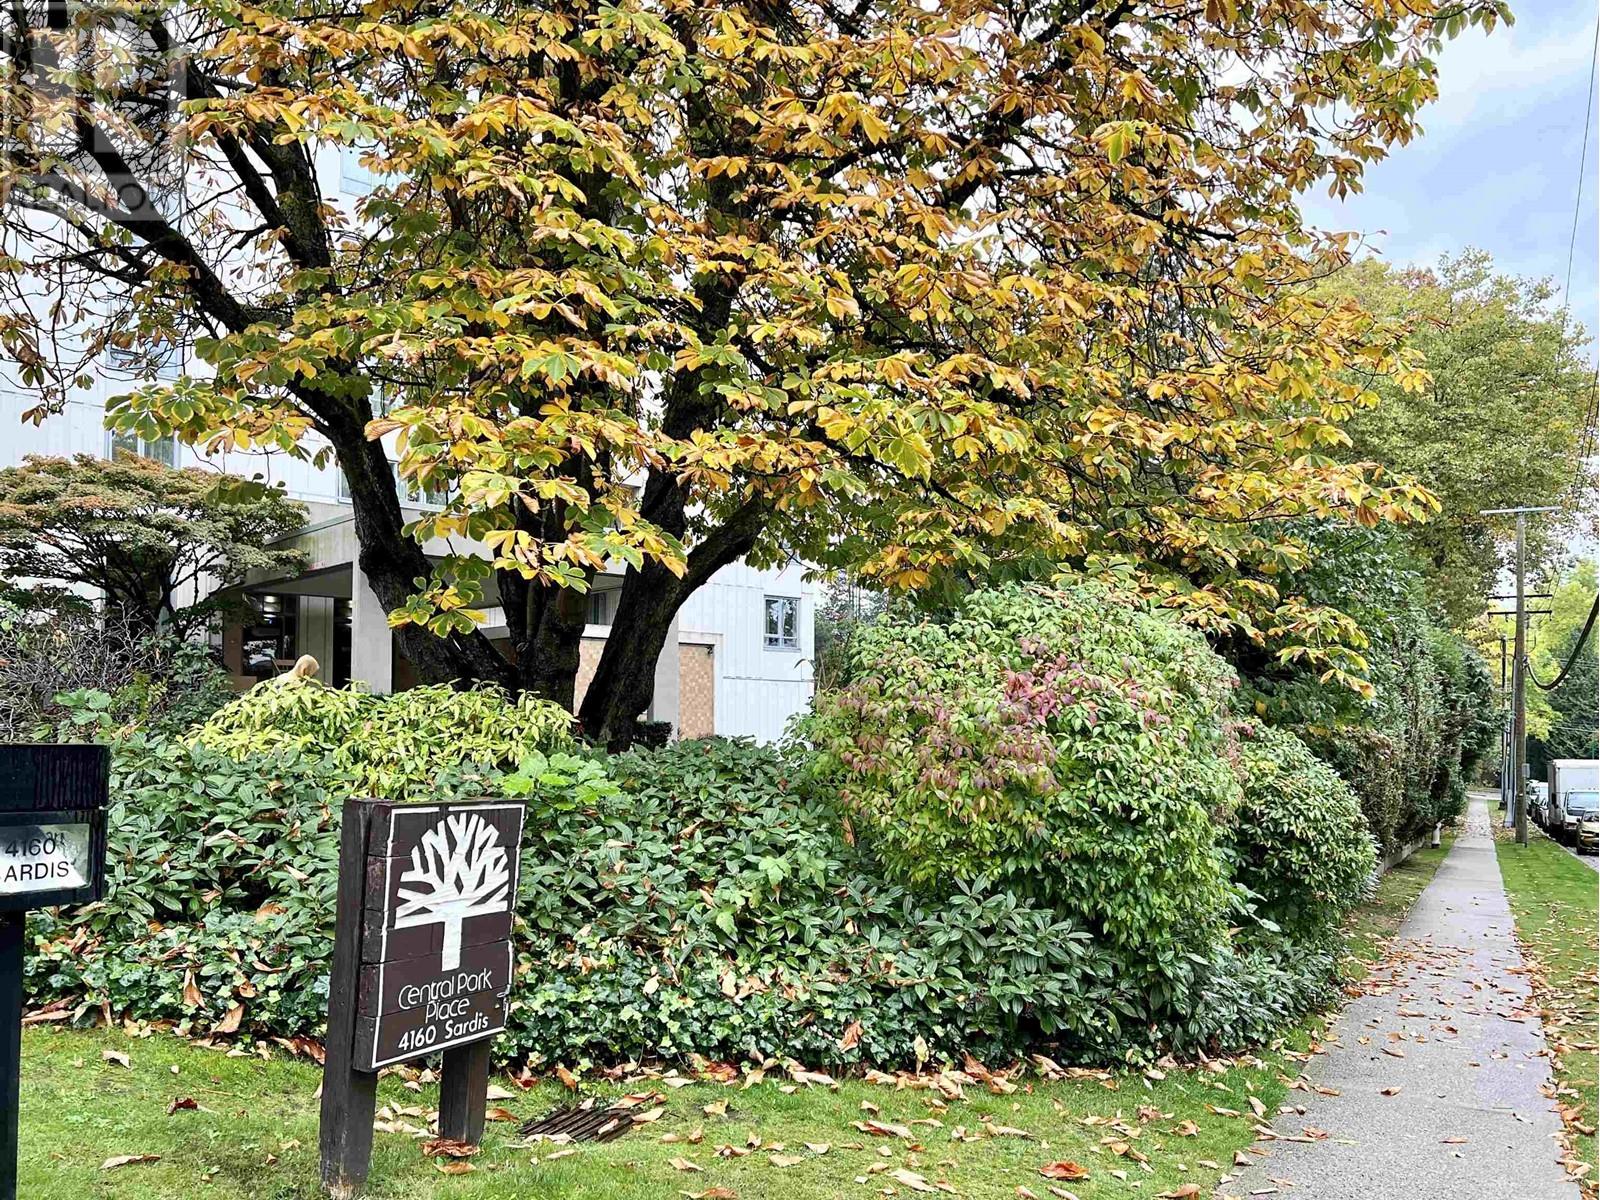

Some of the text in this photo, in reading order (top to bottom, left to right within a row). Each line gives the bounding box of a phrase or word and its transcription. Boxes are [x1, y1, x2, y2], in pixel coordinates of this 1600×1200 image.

[5, 837, 56, 857] 4160
[0, 861, 69, 882] ARDIS
[398, 967, 493, 1010] Central Park
[398, 1012, 489, 1051] 4160 Sardis
